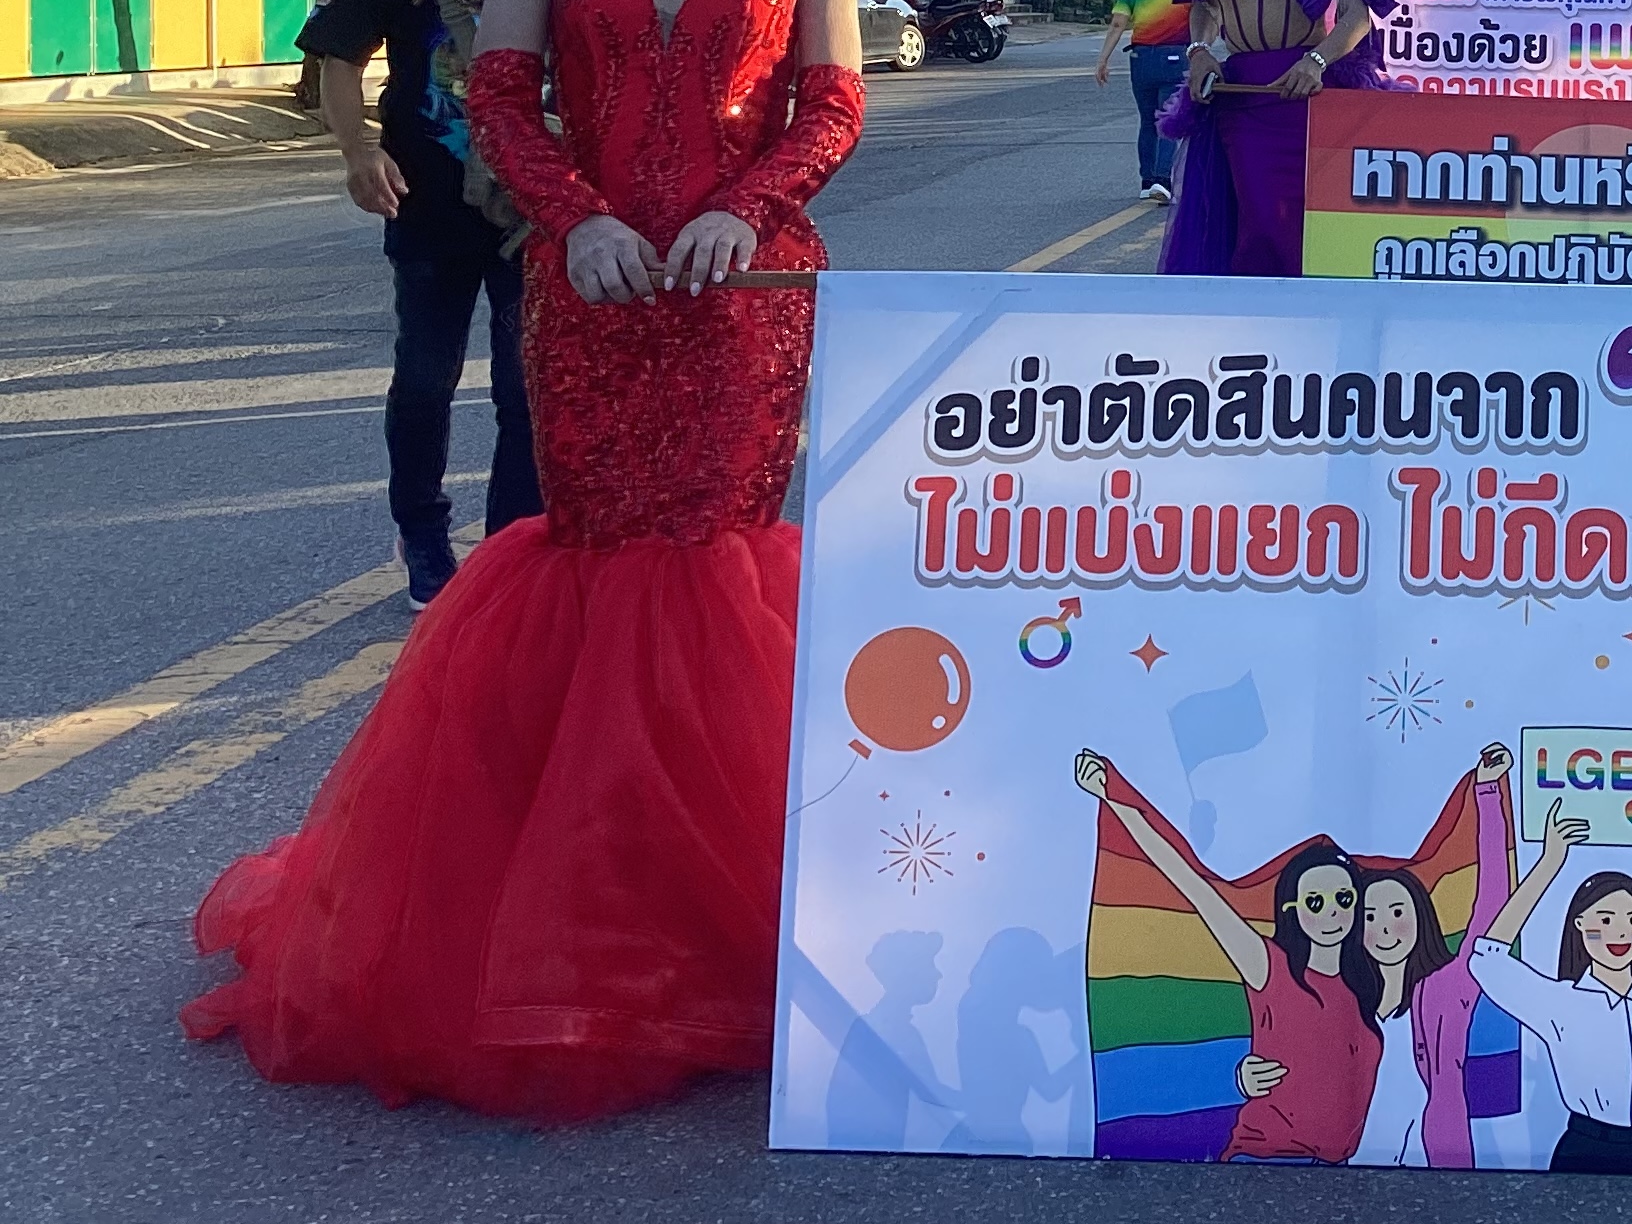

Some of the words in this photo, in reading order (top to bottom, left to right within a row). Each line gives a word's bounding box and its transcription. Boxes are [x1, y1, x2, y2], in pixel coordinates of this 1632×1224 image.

[932, 352, 1580, 451] อย่าตัดสินคนจาก
[912, 468, 1361, 577] ไม่แบ่งแยก
